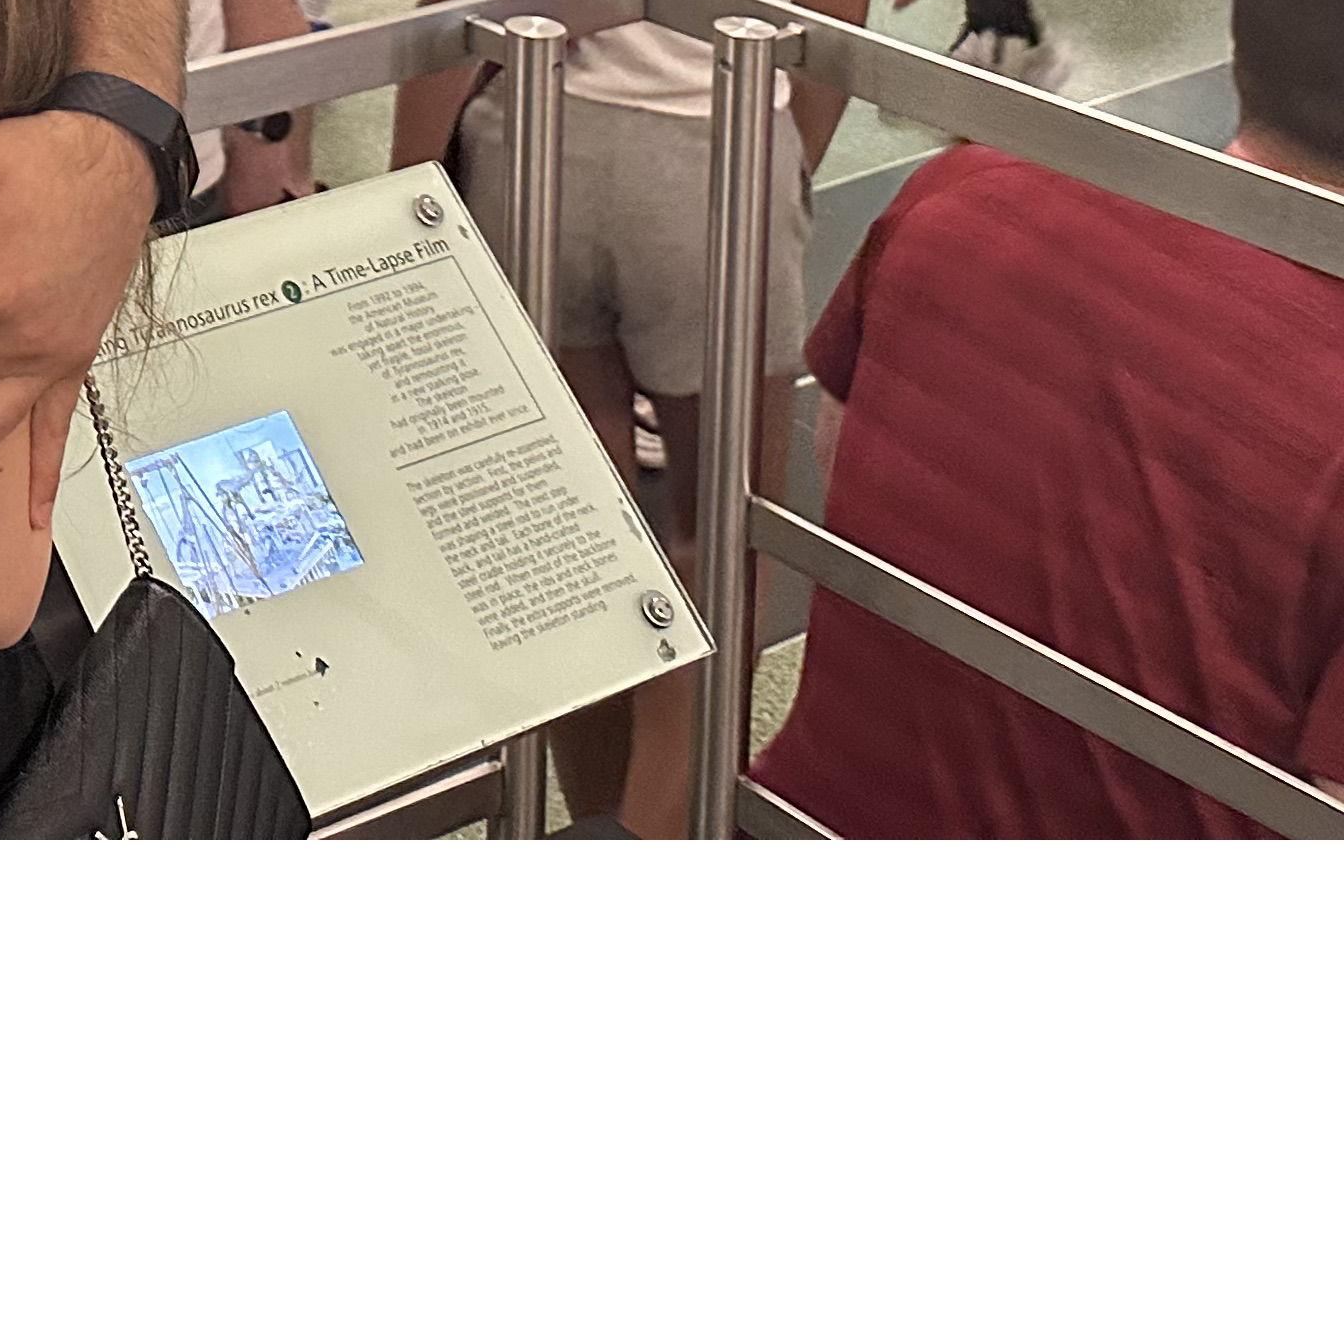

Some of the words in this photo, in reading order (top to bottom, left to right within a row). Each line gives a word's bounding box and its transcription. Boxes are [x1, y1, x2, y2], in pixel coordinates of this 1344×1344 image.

[253, 290, 280, 308] rex
[312, 273, 327, 291] A
[327, 252, 414, 286] Time-Lapse
[415, 238, 450, 262] Film
